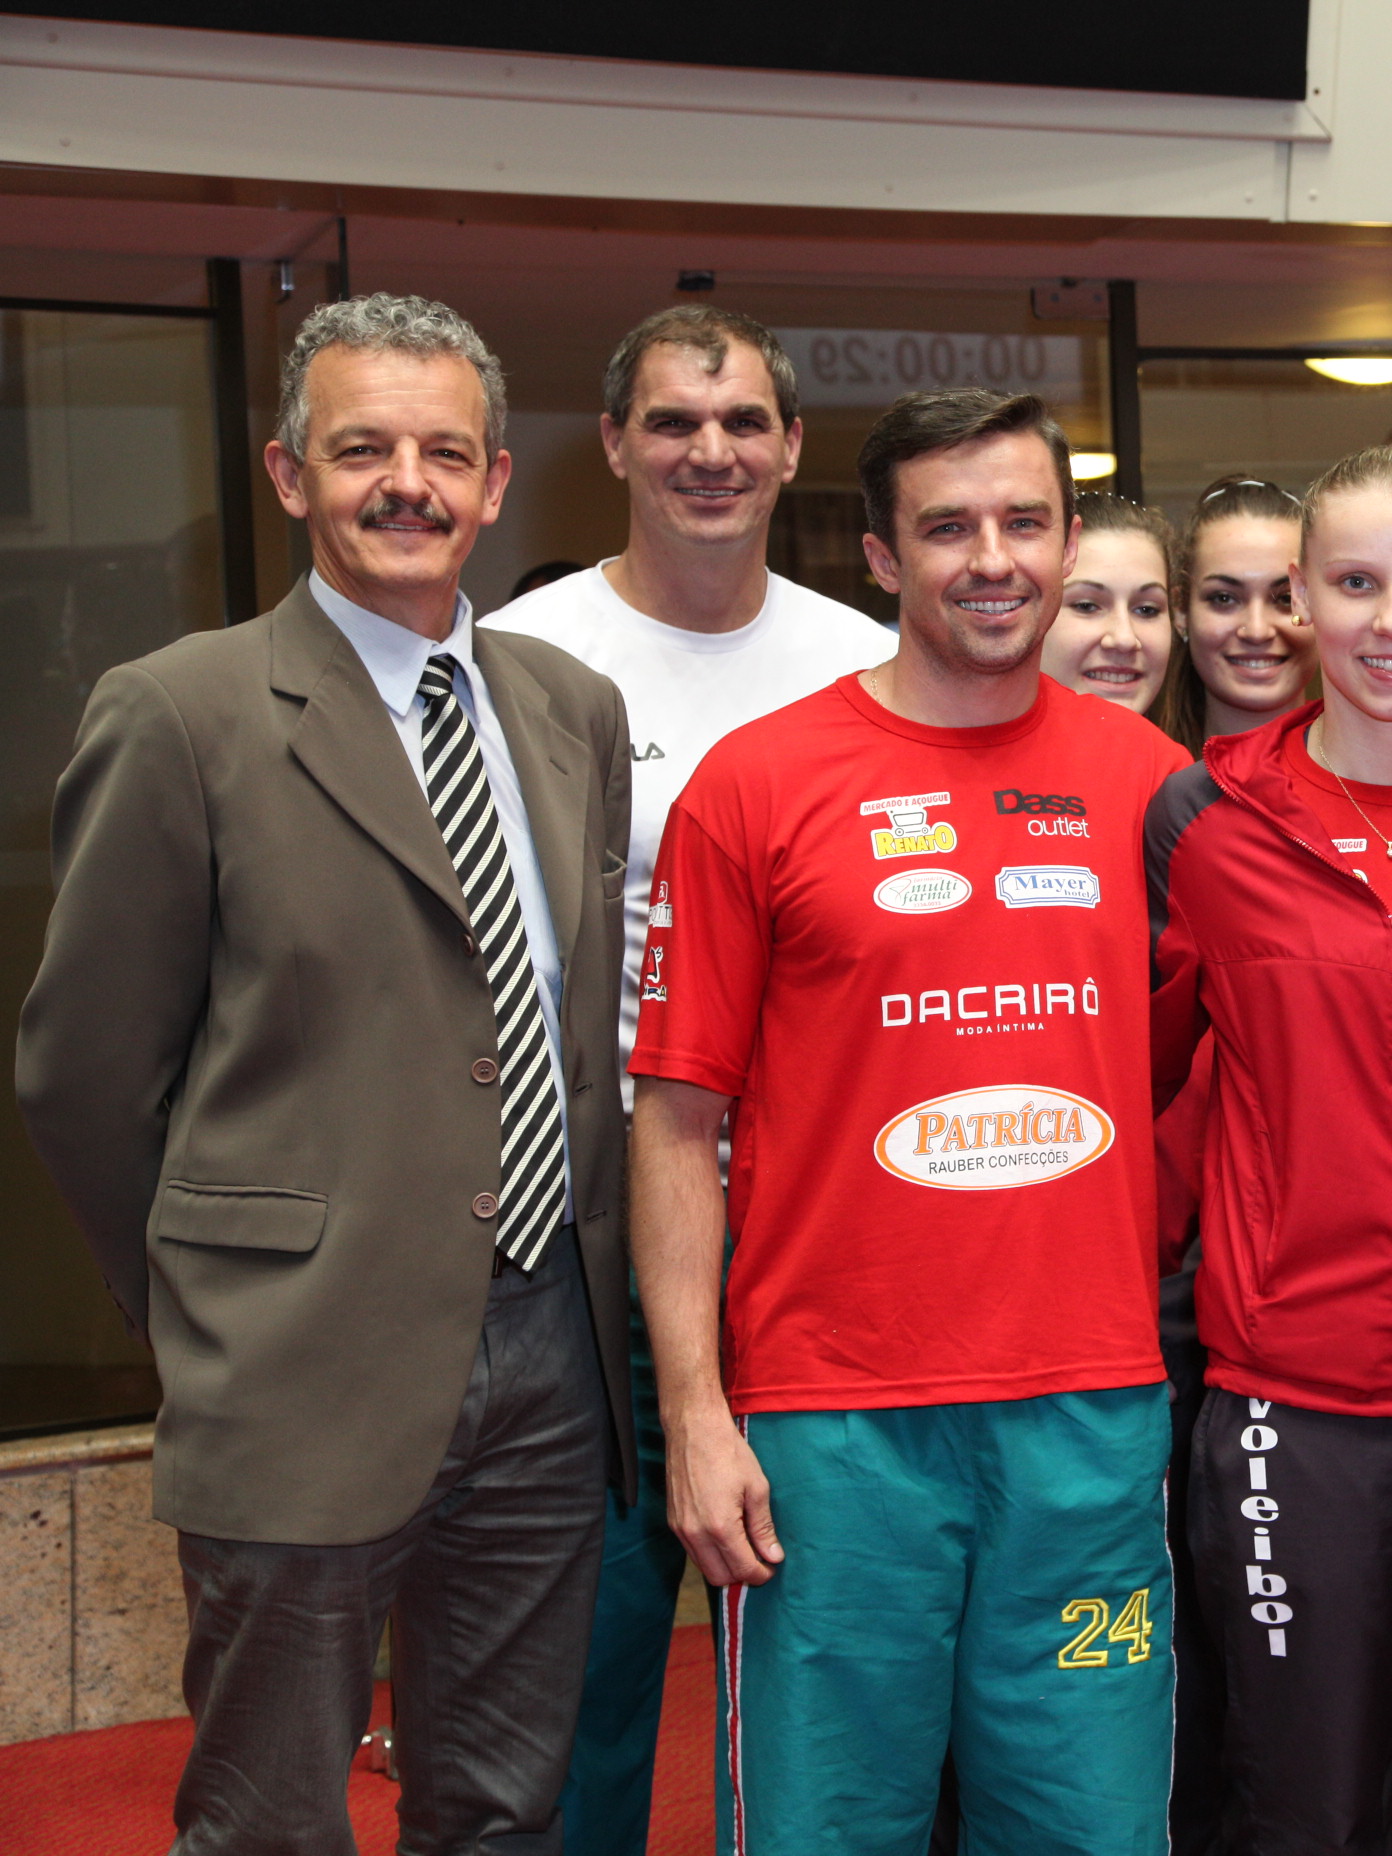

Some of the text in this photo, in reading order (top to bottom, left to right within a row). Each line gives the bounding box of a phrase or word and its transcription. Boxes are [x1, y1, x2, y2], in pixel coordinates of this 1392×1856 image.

[863, 799, 902, 812] MERCADO
[911, 793, 949, 806] AÇOUGUE
[993, 788, 1087, 816] Dass
[1027, 817, 1091, 838] outlet
[874, 825, 955, 857] RENATO
[911, 879, 958, 893] multi
[1014, 875, 1087, 892] Mayer
[1064, 889, 1090, 898] hotel
[901, 891, 951, 906] farma
[881, 977, 1099, 1027] DACRIRÔ
[913, 1101, 1086, 1156] PATRÍCIA
[929, 1149, 1069, 1175] RAUBER CONFECÇÕES
[1057, 1588, 1153, 1669] 24
